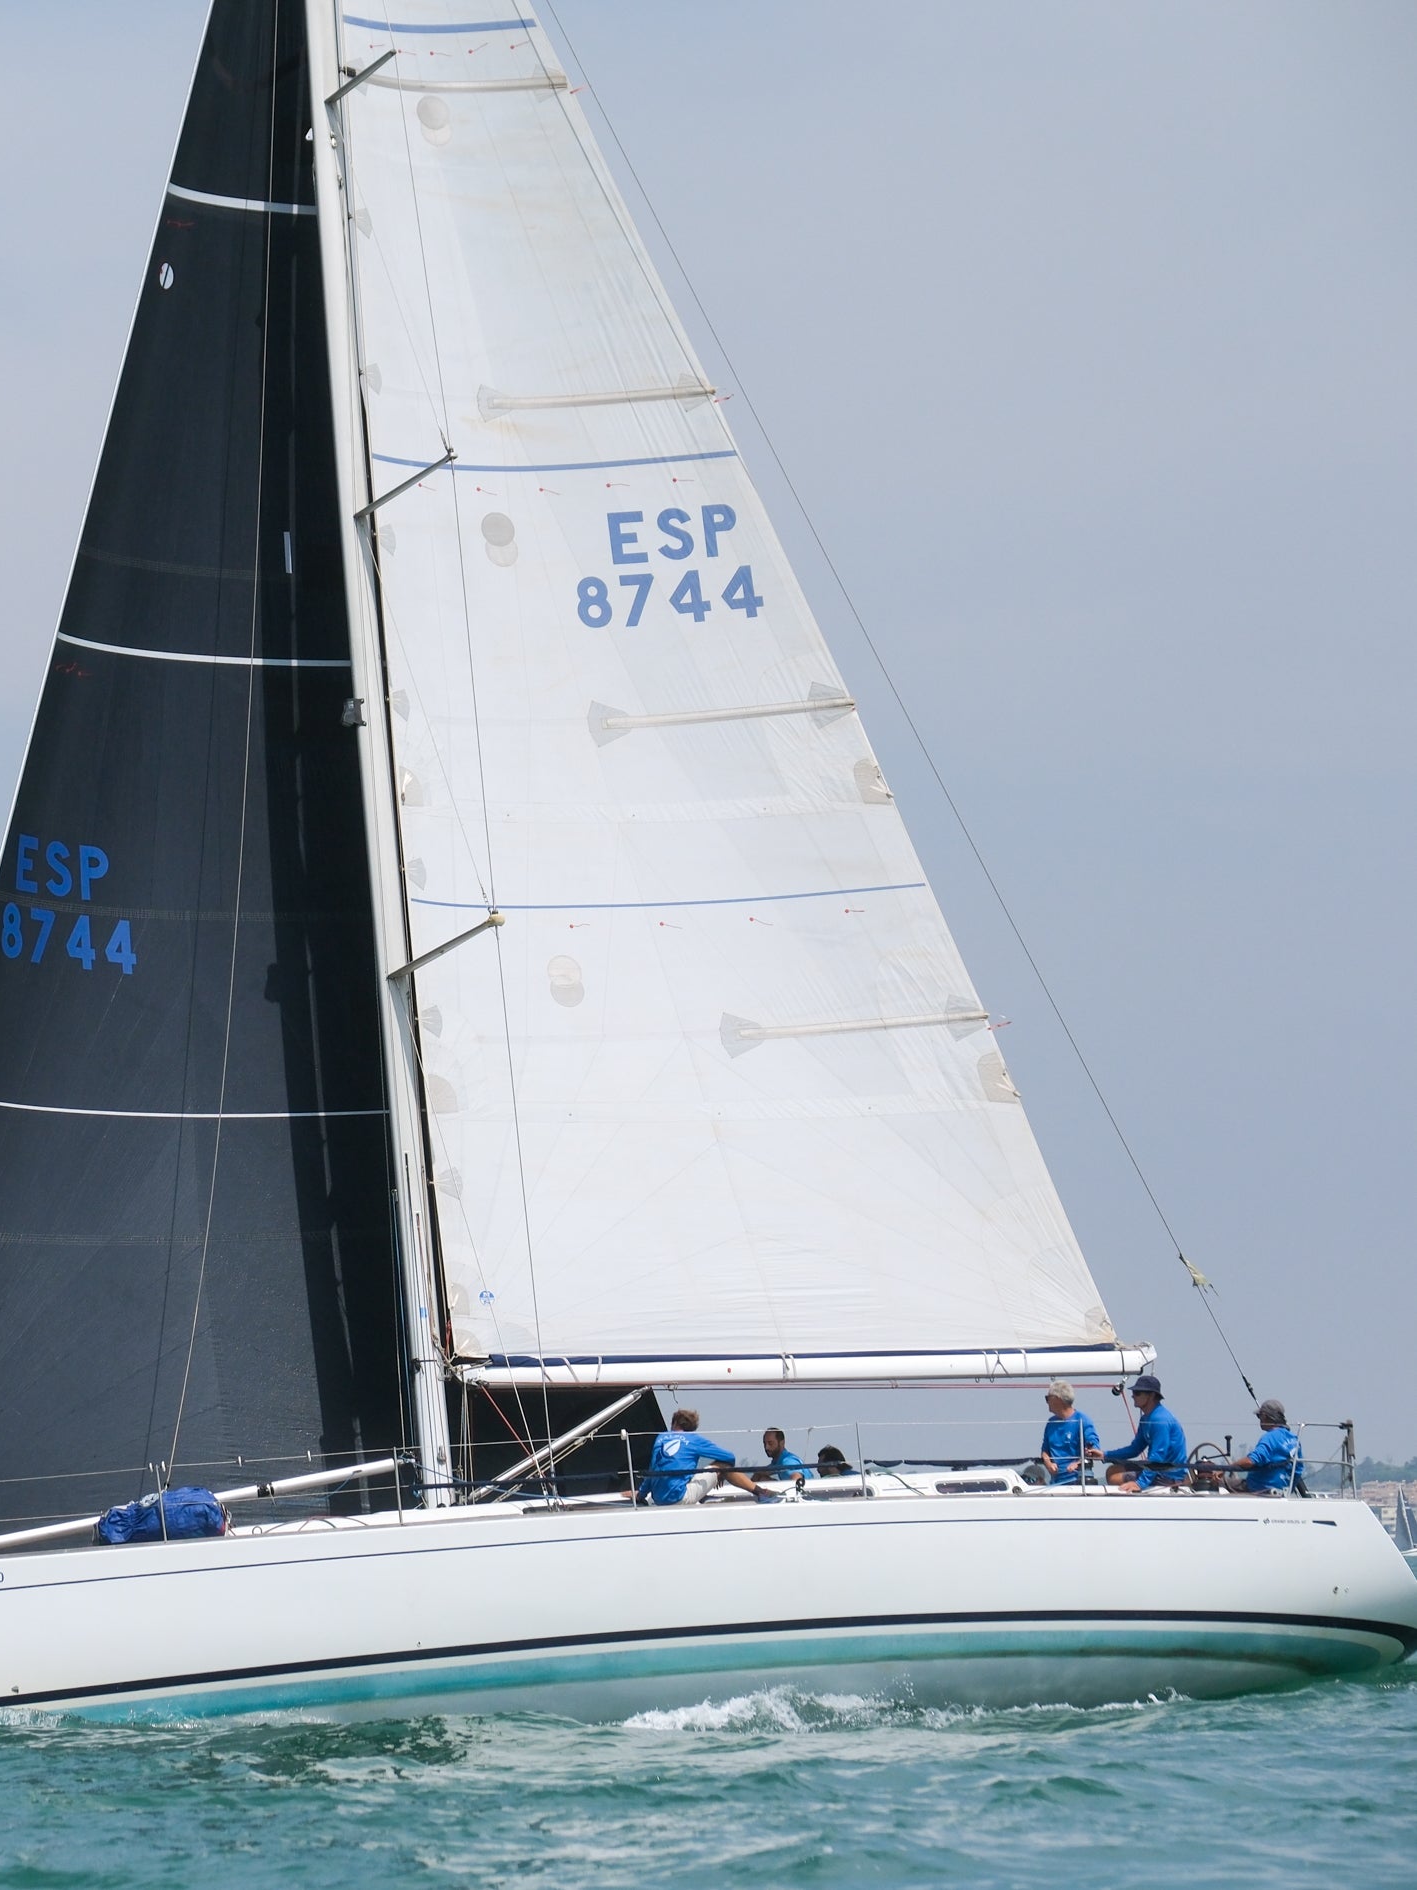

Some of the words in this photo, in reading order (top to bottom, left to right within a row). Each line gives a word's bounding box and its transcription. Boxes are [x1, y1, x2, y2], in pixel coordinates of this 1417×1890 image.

[606, 504, 737, 565] ESP
[576, 564, 765, 629] 8744
[15, 833, 110, 901] ESP
[1, 902, 138, 975] 8744
